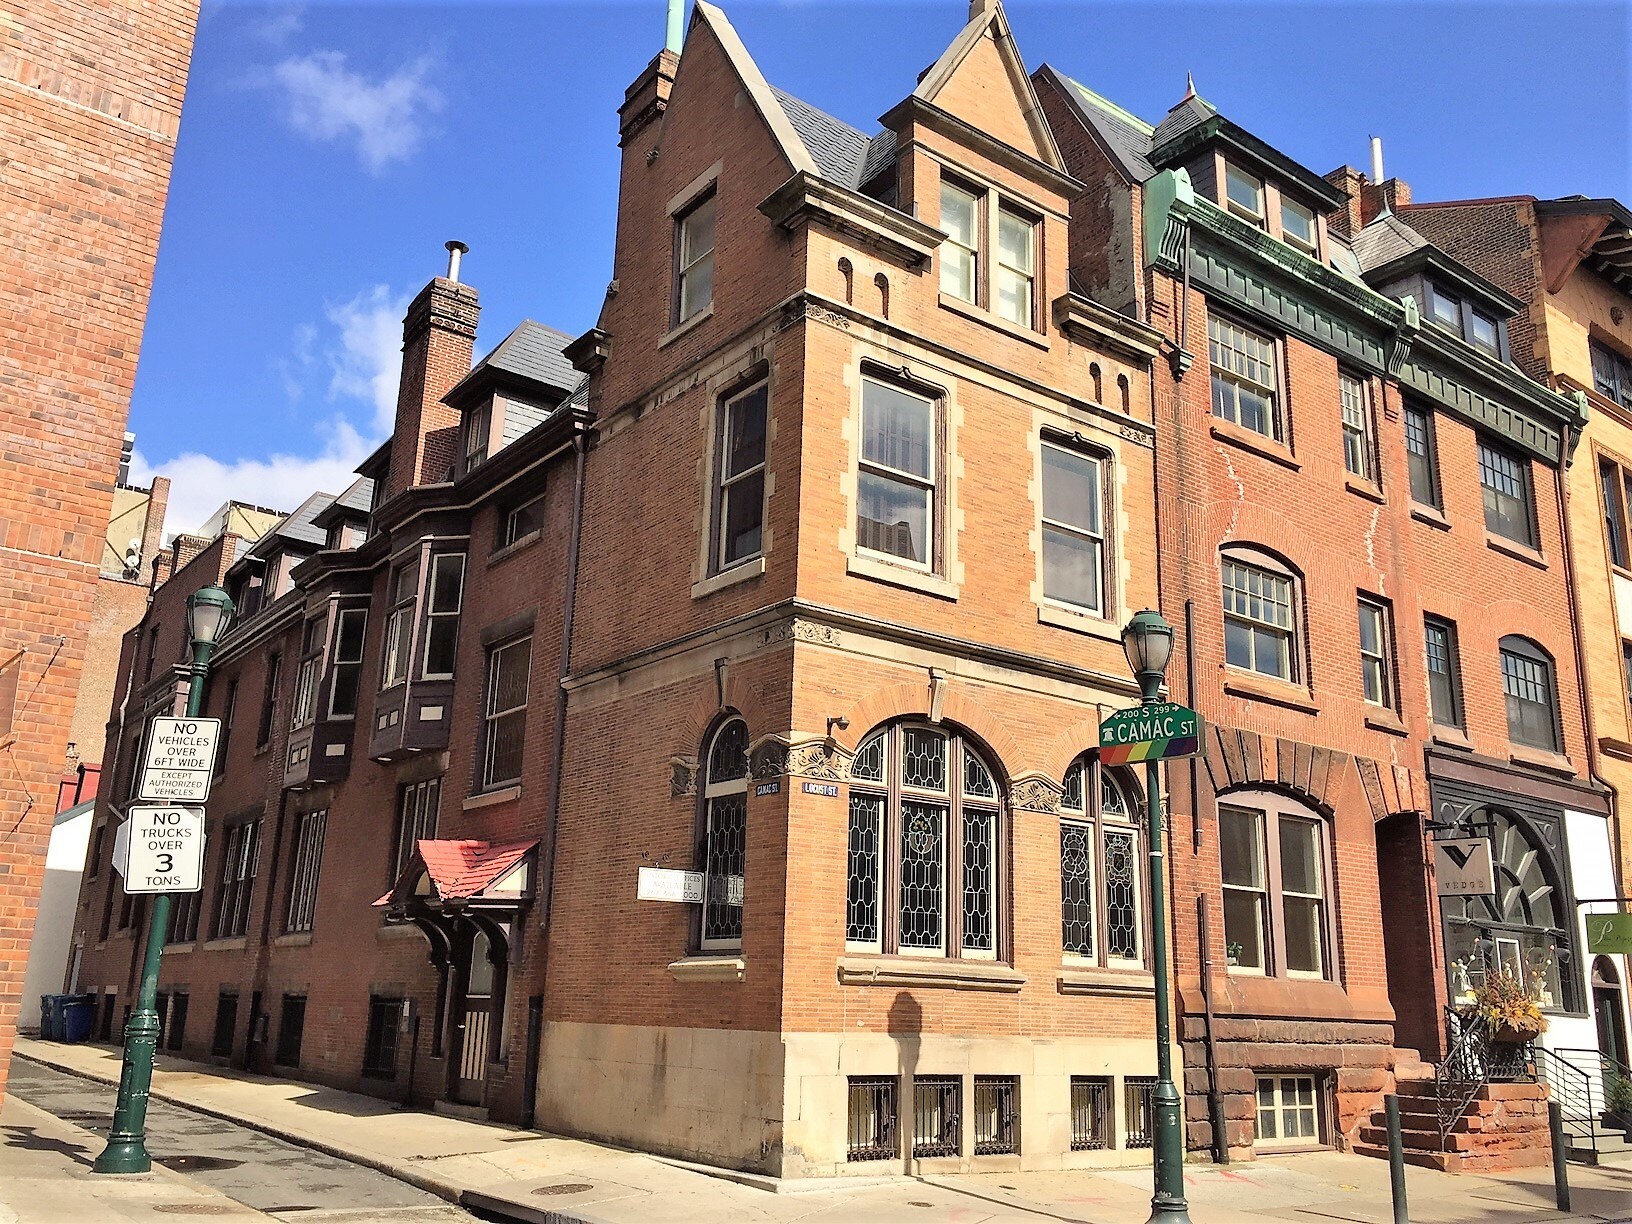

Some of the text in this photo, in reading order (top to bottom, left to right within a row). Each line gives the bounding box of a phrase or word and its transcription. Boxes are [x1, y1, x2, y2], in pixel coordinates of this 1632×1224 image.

[1122, 705, 1170, 719] 200 S 299
[173, 723, 198, 735] NO
[1117, 717, 1194, 743] CAMAC ST
[158, 736, 210, 747] VEHICLES
[167, 747, 197, 757] OVER
[154, 757, 205, 768] 6FT WIDE
[161, 772, 193, 780] EXCEPT
[149, 780, 203, 788] AUTHORIZED
[805, 783, 827, 795] LOCUST
[154, 788, 194, 797] VEHICLES
[757, 784, 772, 796] CAMAC
[153, 812, 181, 826] NO
[141, 828, 192, 838] TRUCKS
[148, 840, 183, 850] OVER
[1440, 843, 1482, 870] V
[155, 853, 174, 873] 3
[145, 876, 181, 886] TONS
[1445, 881, 1485, 889] VEDGE
